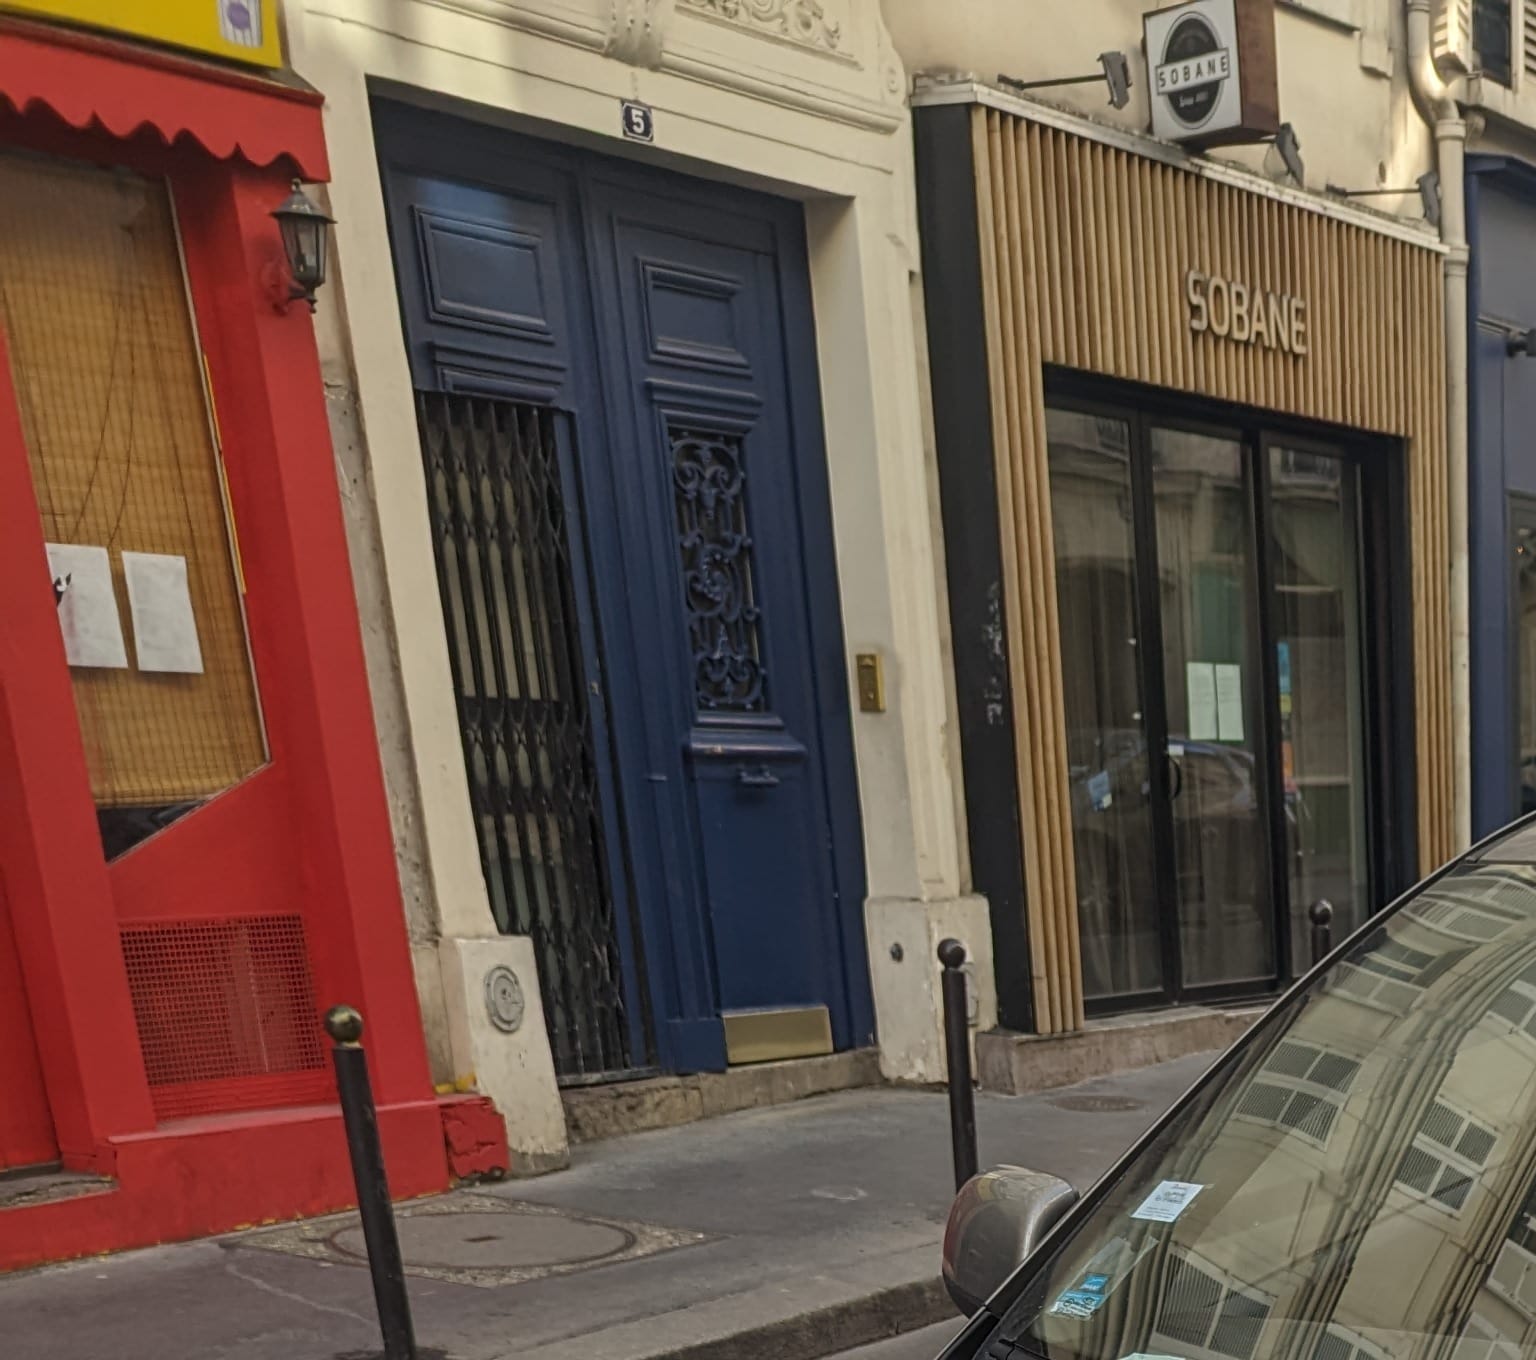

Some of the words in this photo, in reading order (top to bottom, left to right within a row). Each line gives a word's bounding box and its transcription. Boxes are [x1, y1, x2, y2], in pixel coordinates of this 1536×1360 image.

[1158, 55, 1228, 88] SOBANE
[631, 108, 645, 133] 5
[1187, 269, 1307, 355] SOBANE
